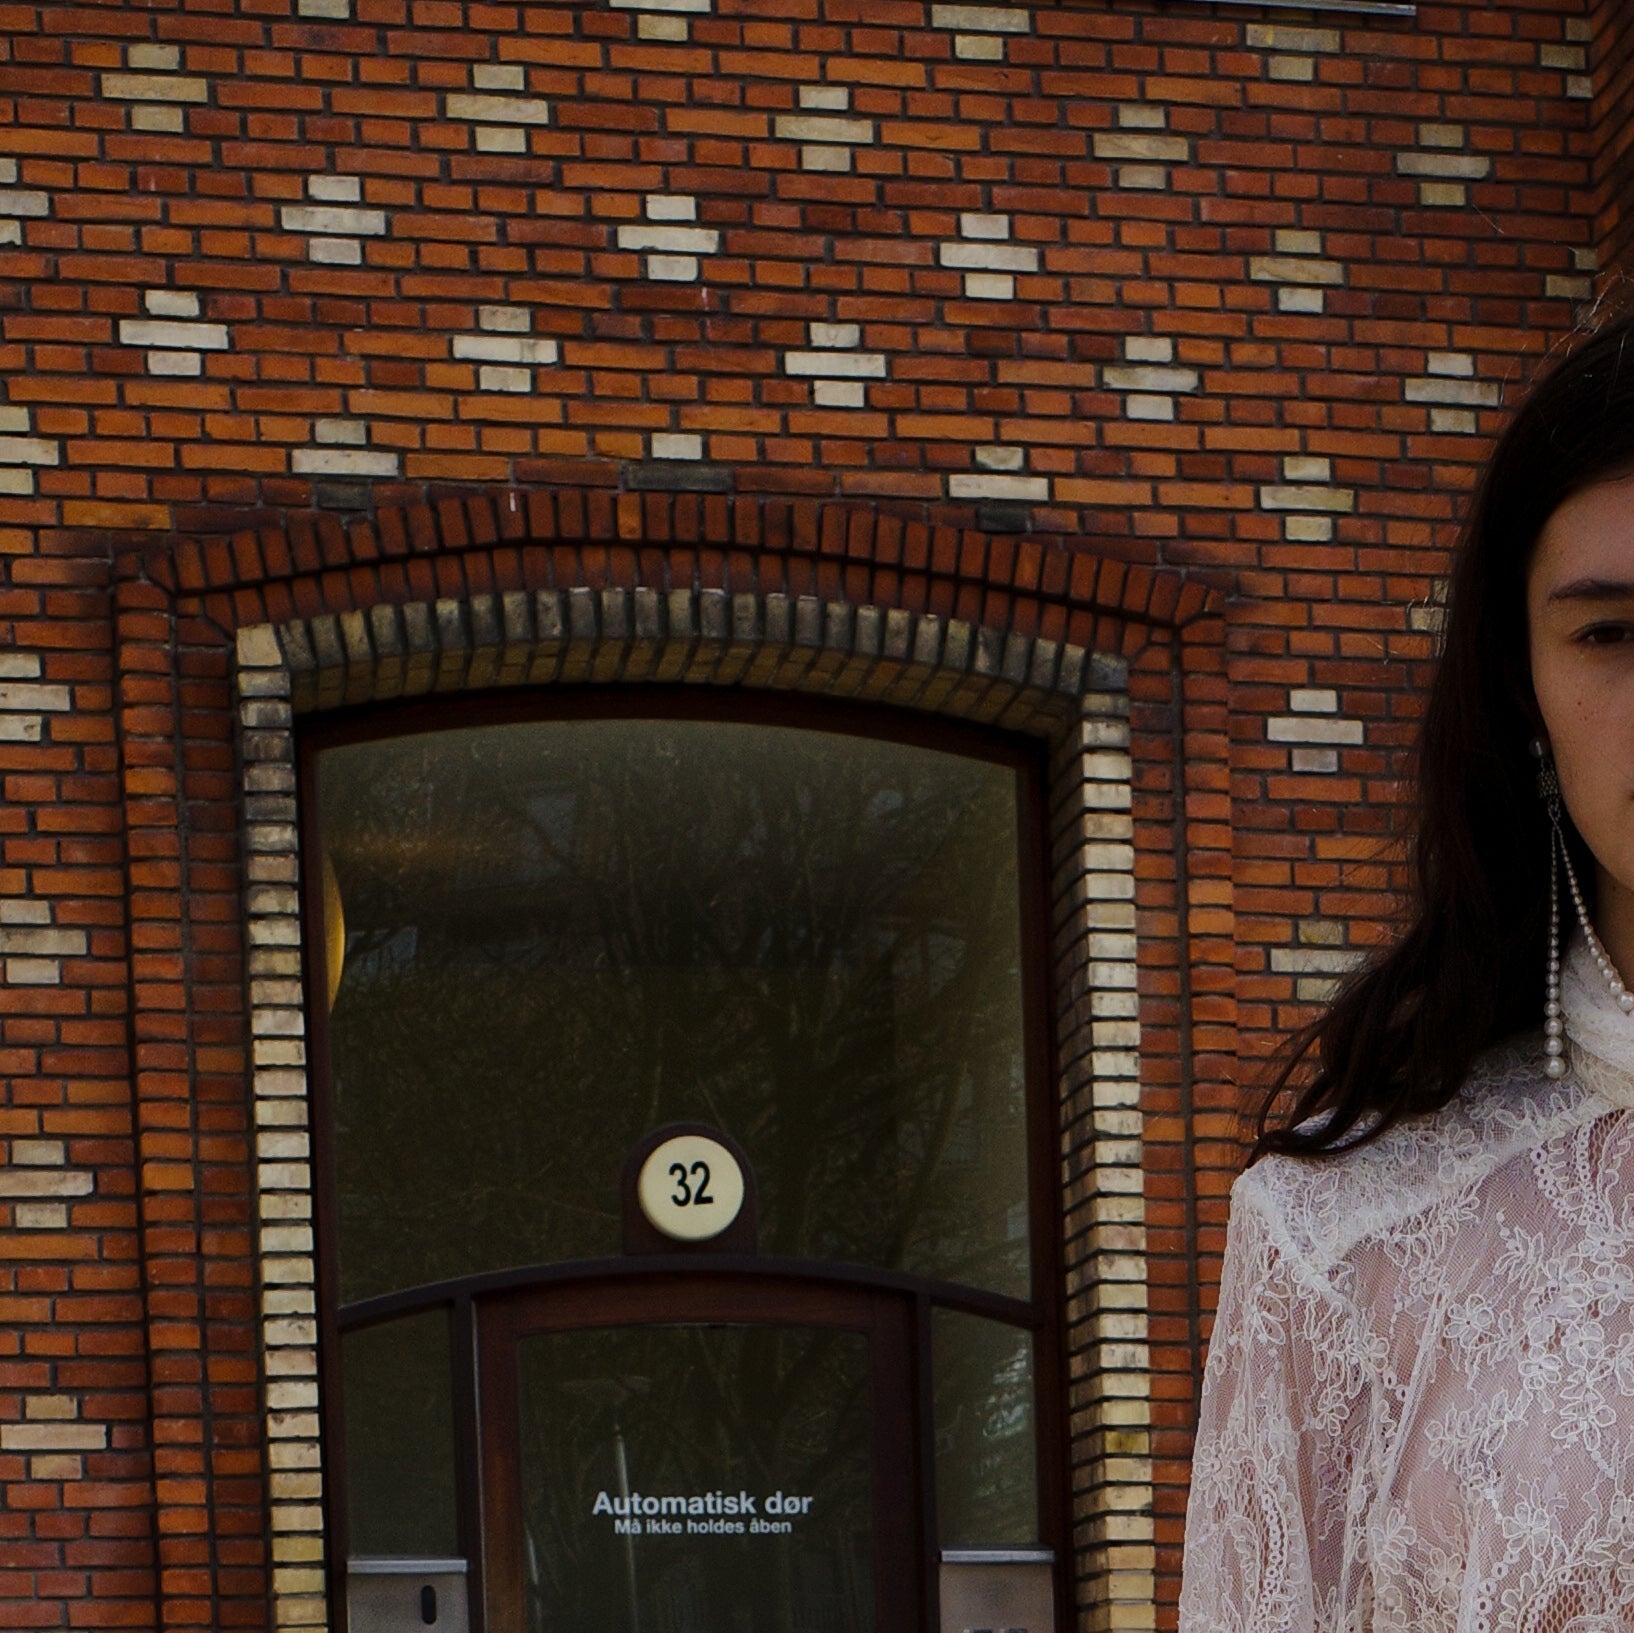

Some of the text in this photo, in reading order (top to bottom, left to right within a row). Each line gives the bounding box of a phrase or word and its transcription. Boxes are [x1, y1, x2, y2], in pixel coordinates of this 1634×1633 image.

[667, 1160, 714, 1207] 32
[592, 1490, 813, 1515] Automatisk dør
[614, 1517, 792, 1534] Må ikke holdes åben
